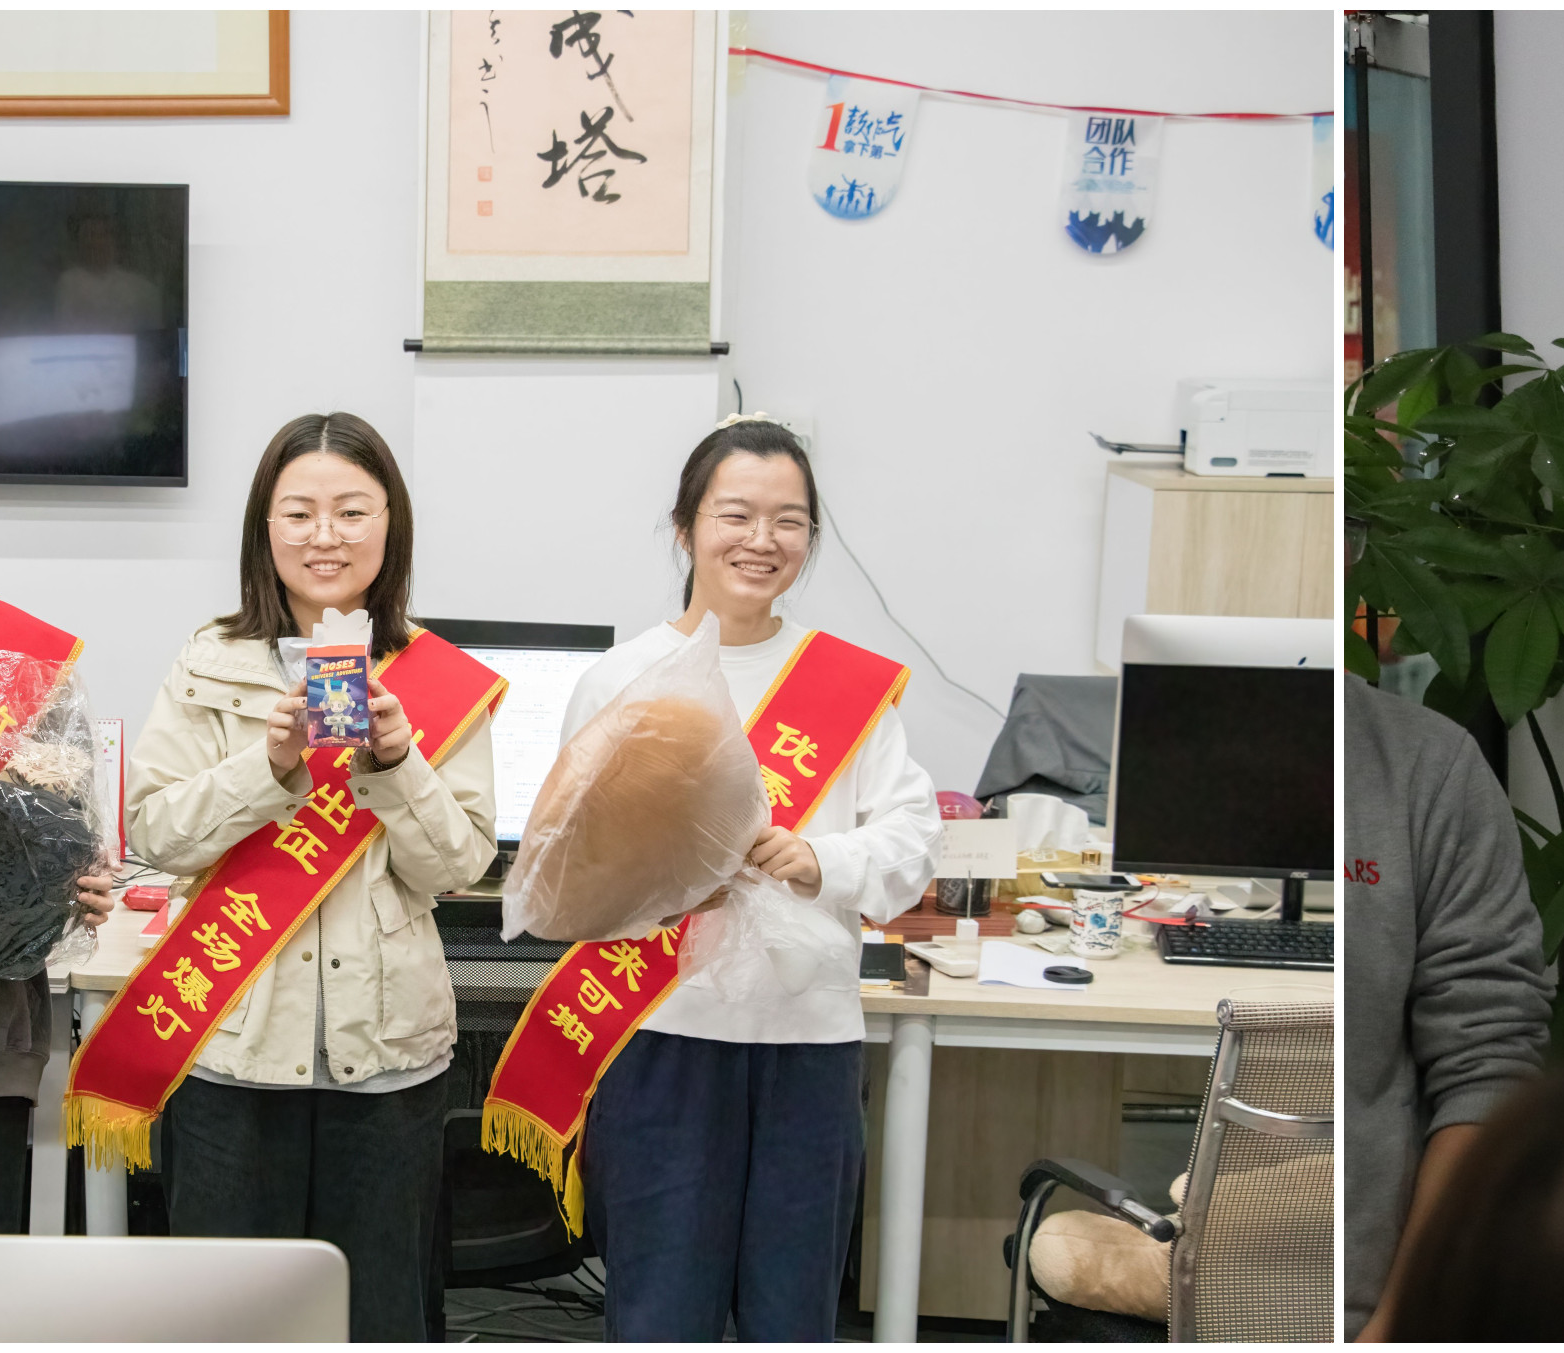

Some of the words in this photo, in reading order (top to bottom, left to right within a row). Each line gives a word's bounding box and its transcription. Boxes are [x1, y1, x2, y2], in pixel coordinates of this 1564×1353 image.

[1085, 116, 1136, 147] 团队
[1083, 146, 1135, 177] 合作
[319, 659, 356, 673] MOSES
[136, 886, 272, 1041] 全场爆灯
